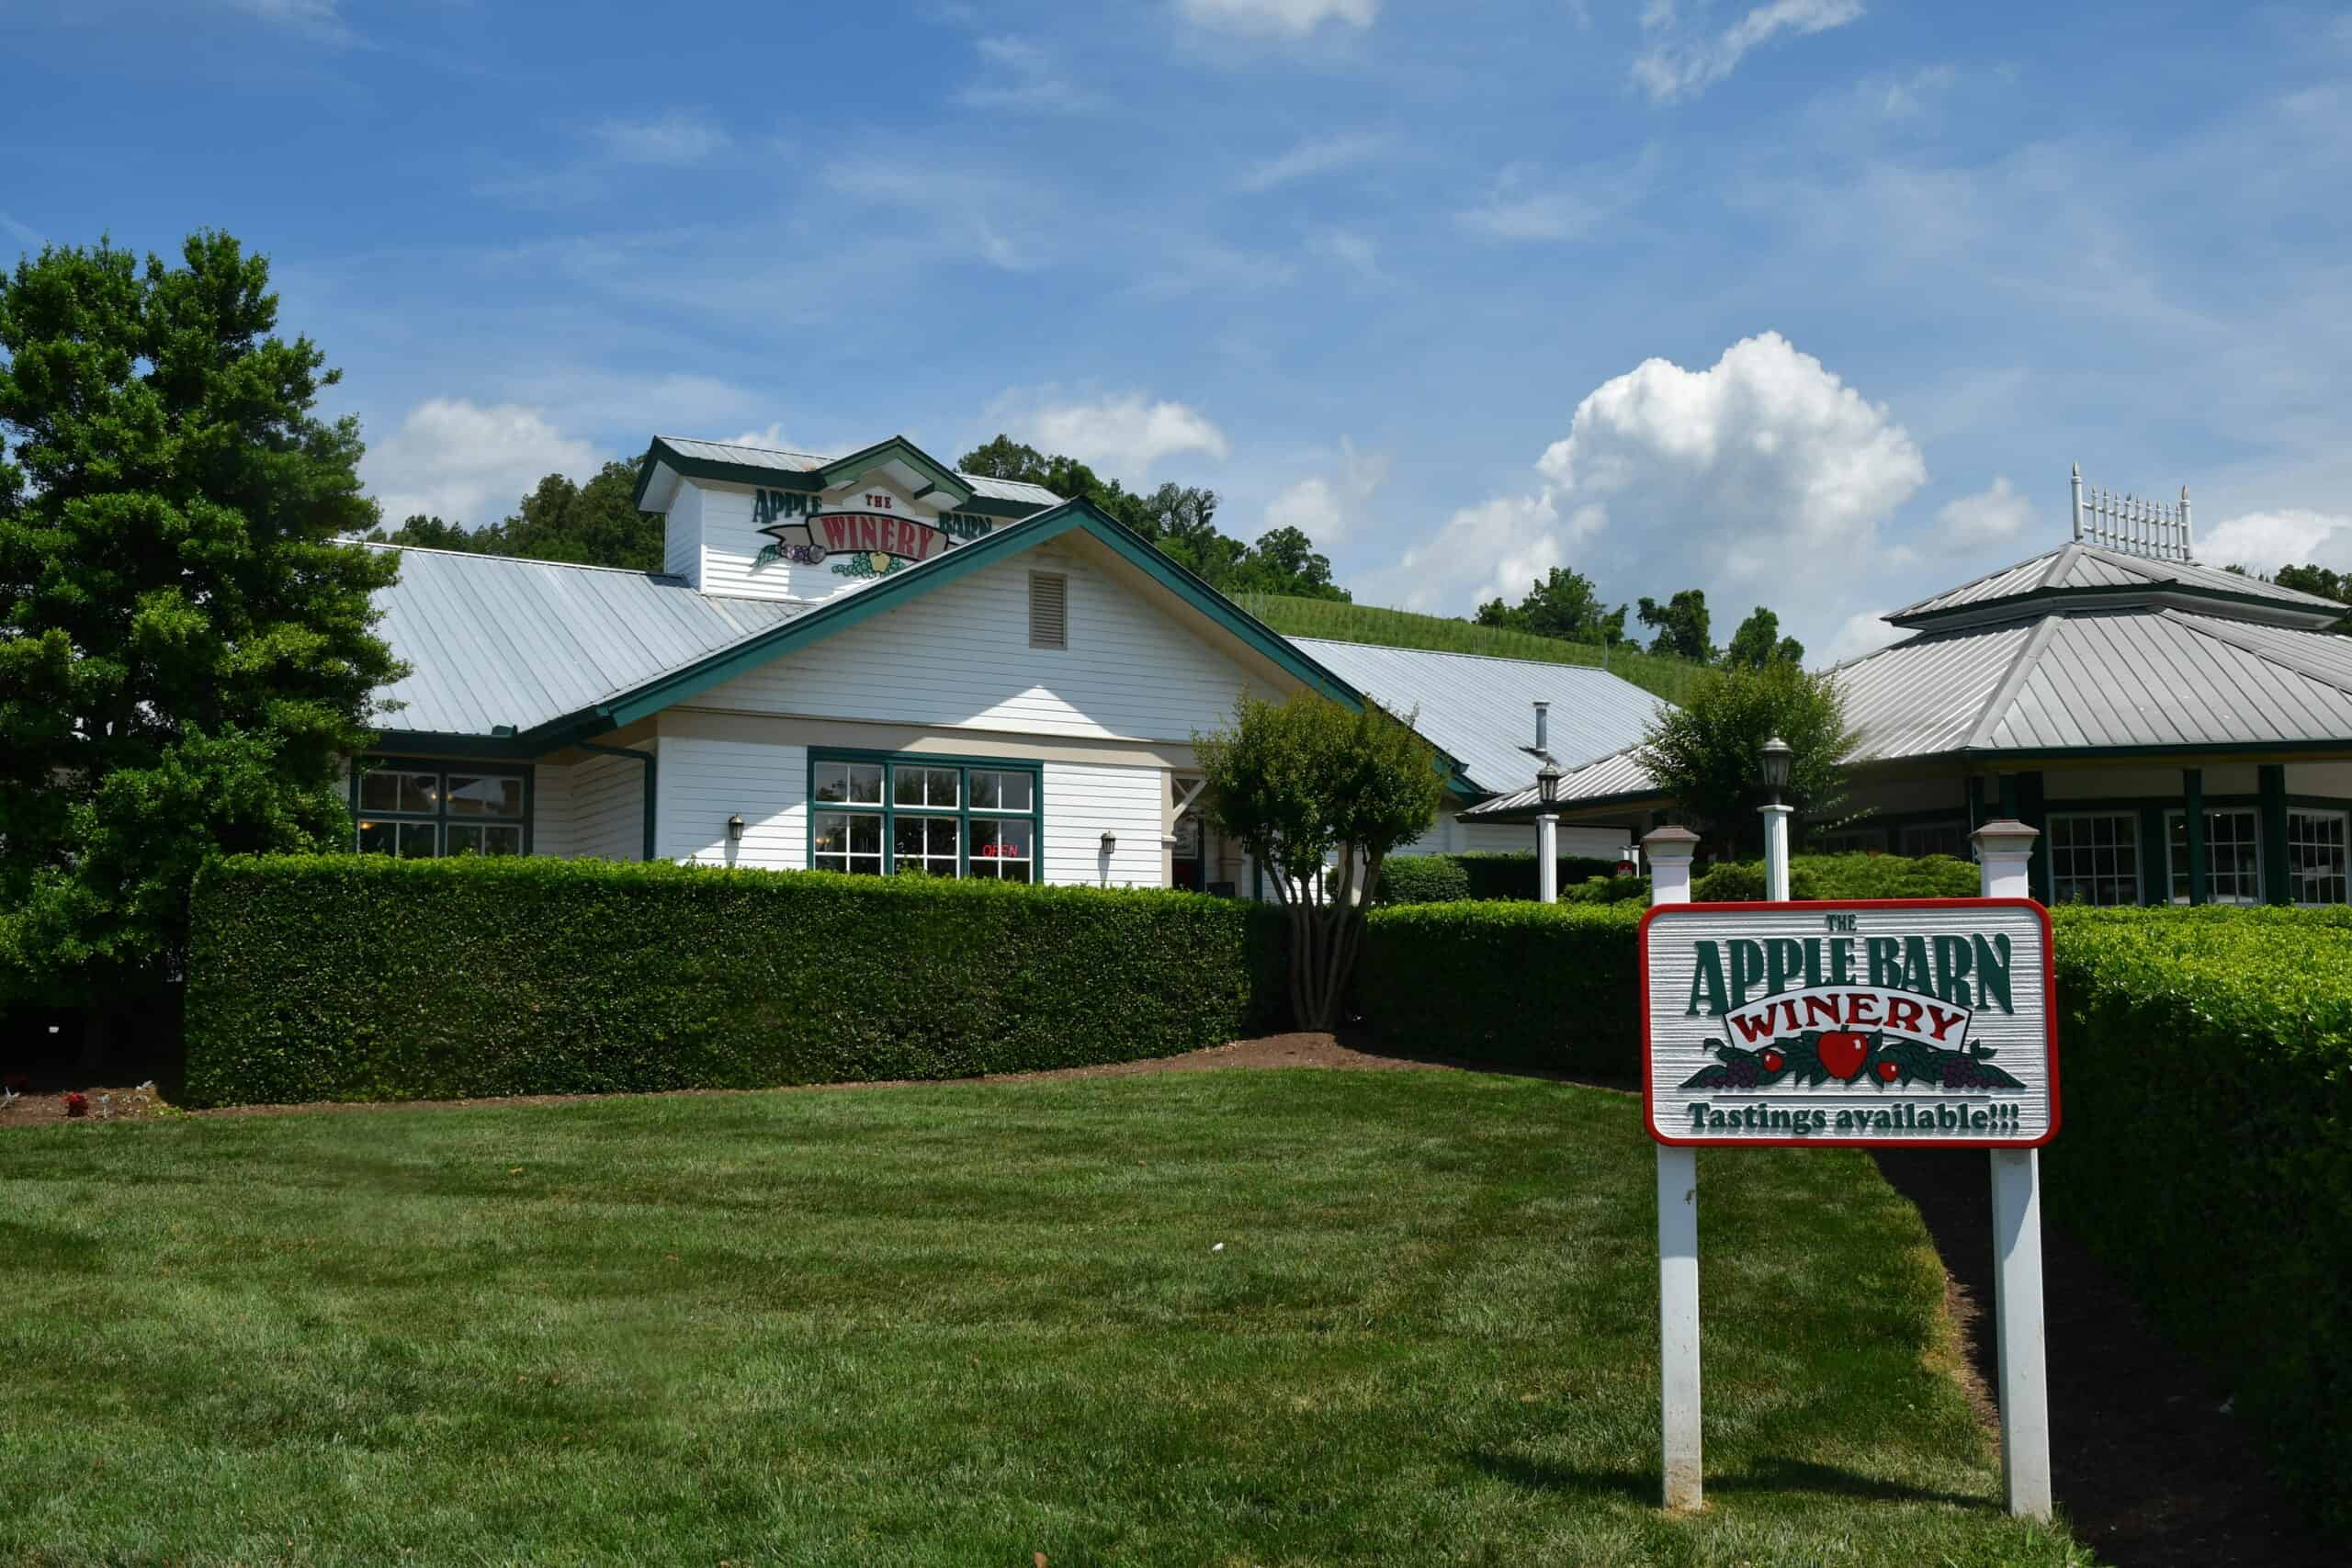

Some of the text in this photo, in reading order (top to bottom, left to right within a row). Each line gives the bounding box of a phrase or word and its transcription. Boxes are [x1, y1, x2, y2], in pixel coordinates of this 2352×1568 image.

[752, 488, 993, 540] APPLE BARN
[865, 494, 891, 509] THE
[820, 514, 935, 559] WINERY
[982, 843, 1018, 857] OPEN
[1826, 914, 1857, 931] THE
[1685, 932, 2015, 1016] APPLE BARN
[1731, 993, 1965, 1043] WINERY
[1688, 1102, 2019, 1134] Tastings available!!!
